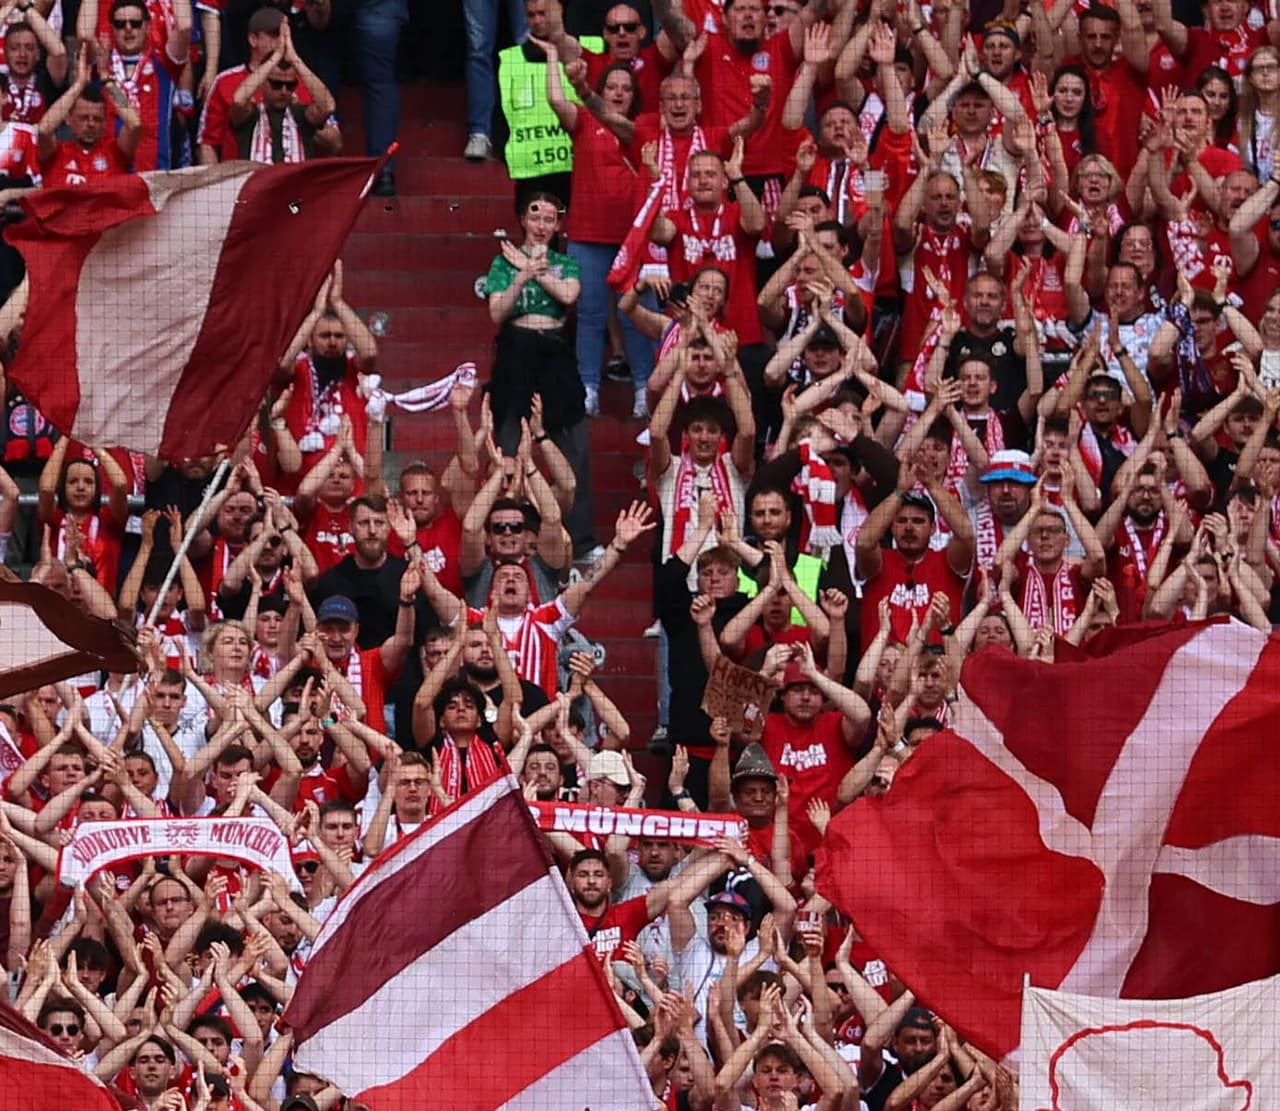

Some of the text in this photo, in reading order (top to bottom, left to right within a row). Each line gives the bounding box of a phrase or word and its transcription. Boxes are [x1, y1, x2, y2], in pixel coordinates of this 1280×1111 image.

[515, 124, 571, 143] STEW
[533, 145, 574, 165] 150
[553, 807, 747, 841] MÜNCHEN
[72, 822, 284, 869] SÜDKURVE MÜNCHEN
